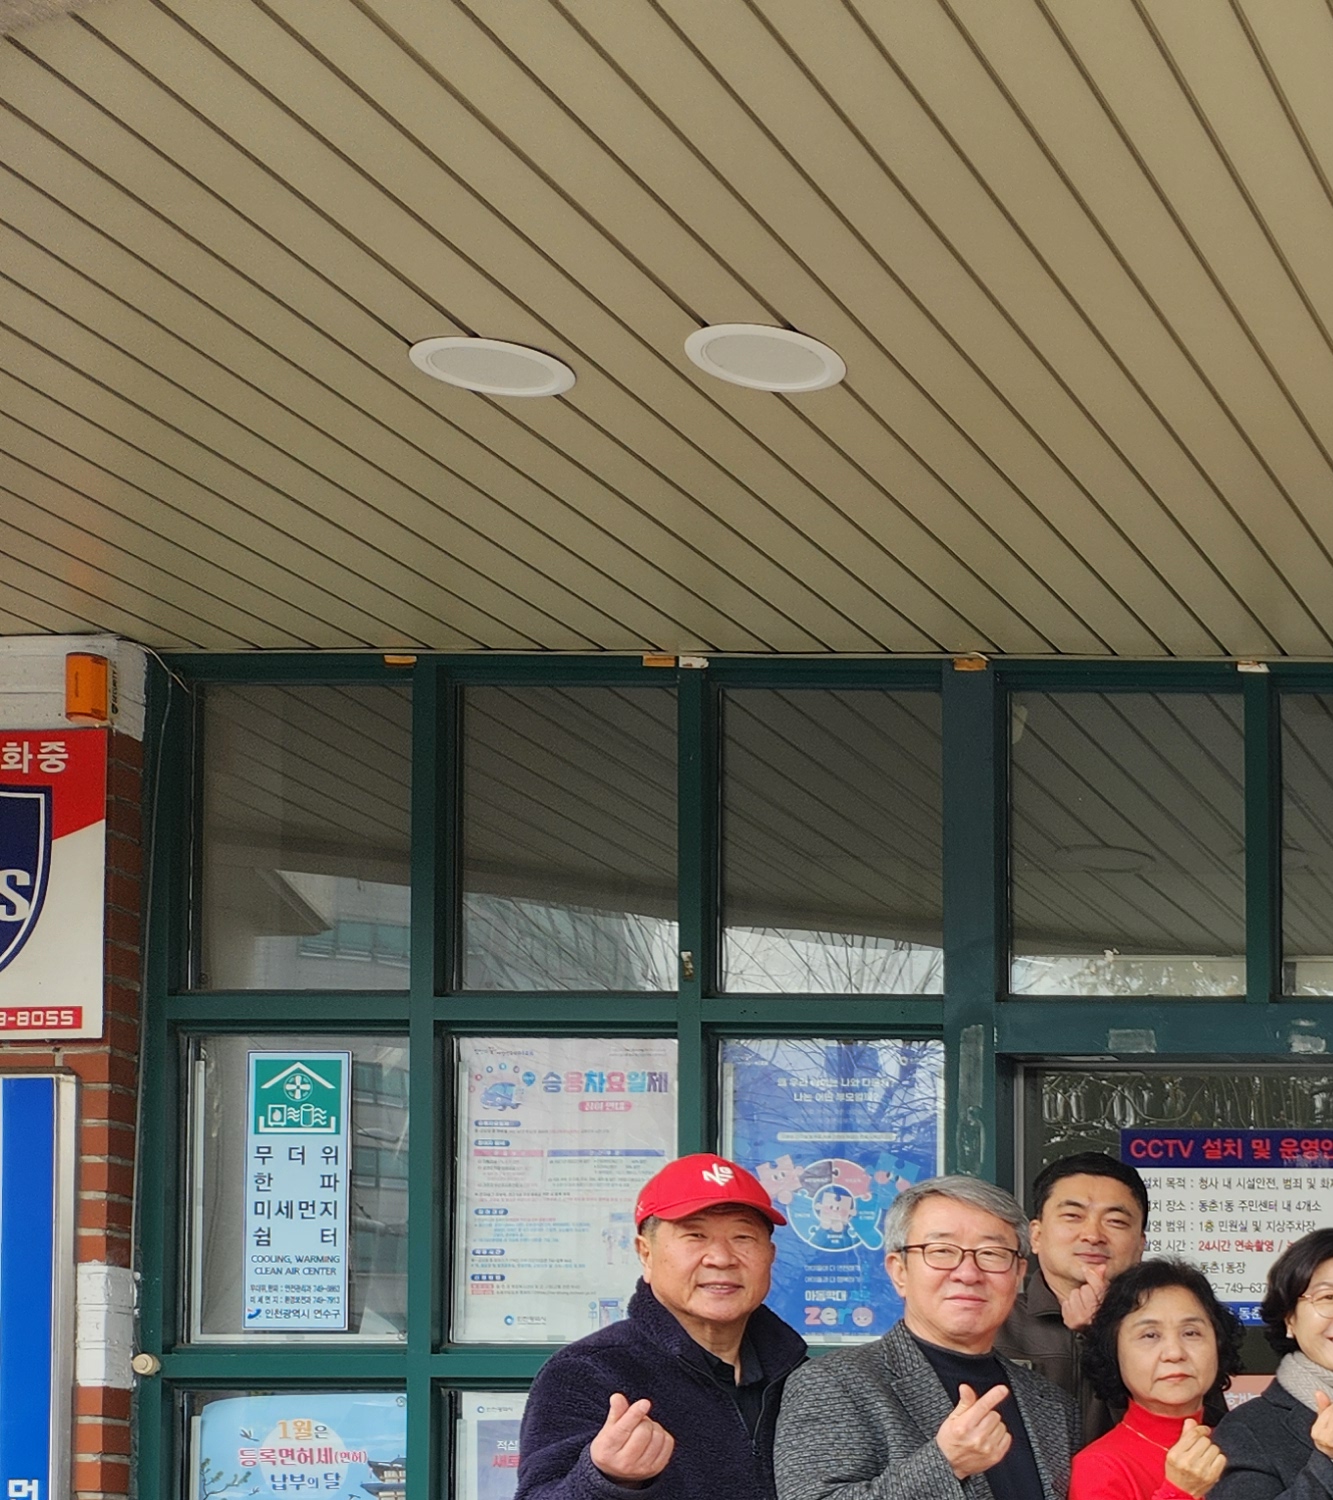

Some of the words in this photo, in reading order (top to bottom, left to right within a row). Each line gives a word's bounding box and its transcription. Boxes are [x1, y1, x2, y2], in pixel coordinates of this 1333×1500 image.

[1, 741, 69, 774] 화중
[0, 869, 31, 922] S
[542, 1070, 668, 1093] 승용차요일제
[794, 1093, 812, 1102] 나는
[253, 1145, 339, 1165] 무더위
[1130, 1139, 1194, 1159] CCTV
[1202, 1138, 1242, 1160] 설치
[1251, 1139, 1271, 1160] 및
[1166, 1177, 1186, 1190] 목적
[1199, 1177, 1218, 1190] 청사
[1223, 1177, 1232, 1190] 내
[1236, 1177, 1279, 1190] 시설안전,
[1283, 1177, 1302, 1190] 범죄
[1306, 1177, 1316, 1189] 및
[254, 1201, 337, 1220] 미세먼지
[1166, 1200, 1186, 1212] 장소
[1199, 1200, 1234, 1212] 동춘1동
[1238, 1200, 1278, 1212] 주민센터
[1282, 1200, 1291, 1212] 내
[1295, 1200, 1321, 1212] 4개소
[1166, 1220, 1186, 1232] 범위
[1199, 1220, 1214, 1232] 1층
[1218, 1220, 1248, 1232] 민원실
[1252, 1220, 1262, 1232] 및
[1266, 1220, 1315, 1232] 지상주차장
[1166, 1239, 1186, 1252] 시간
[1198, 1239, 1231, 1252] 24시간
[1234, 1239, 1274, 1252] 연속촬영
[251, 1255, 292, 1265] COOLING,
[295, 1255, 340, 1264] WARMING
[255, 1266, 283, 1276] CLEAN
[285, 1266, 300, 1276] AIR
[303, 1266, 336, 1276] CENTER
[265, 1308, 310, 1319] 인천광역시
[314, 1309, 340, 1319] 연수구
[278, 1419, 329, 1440] 1월은
[239, 1448, 368, 1466] 등록면허세(면허)
[270, 1473, 319, 1491] 납부의
[324, 1472, 341, 1490] 달
